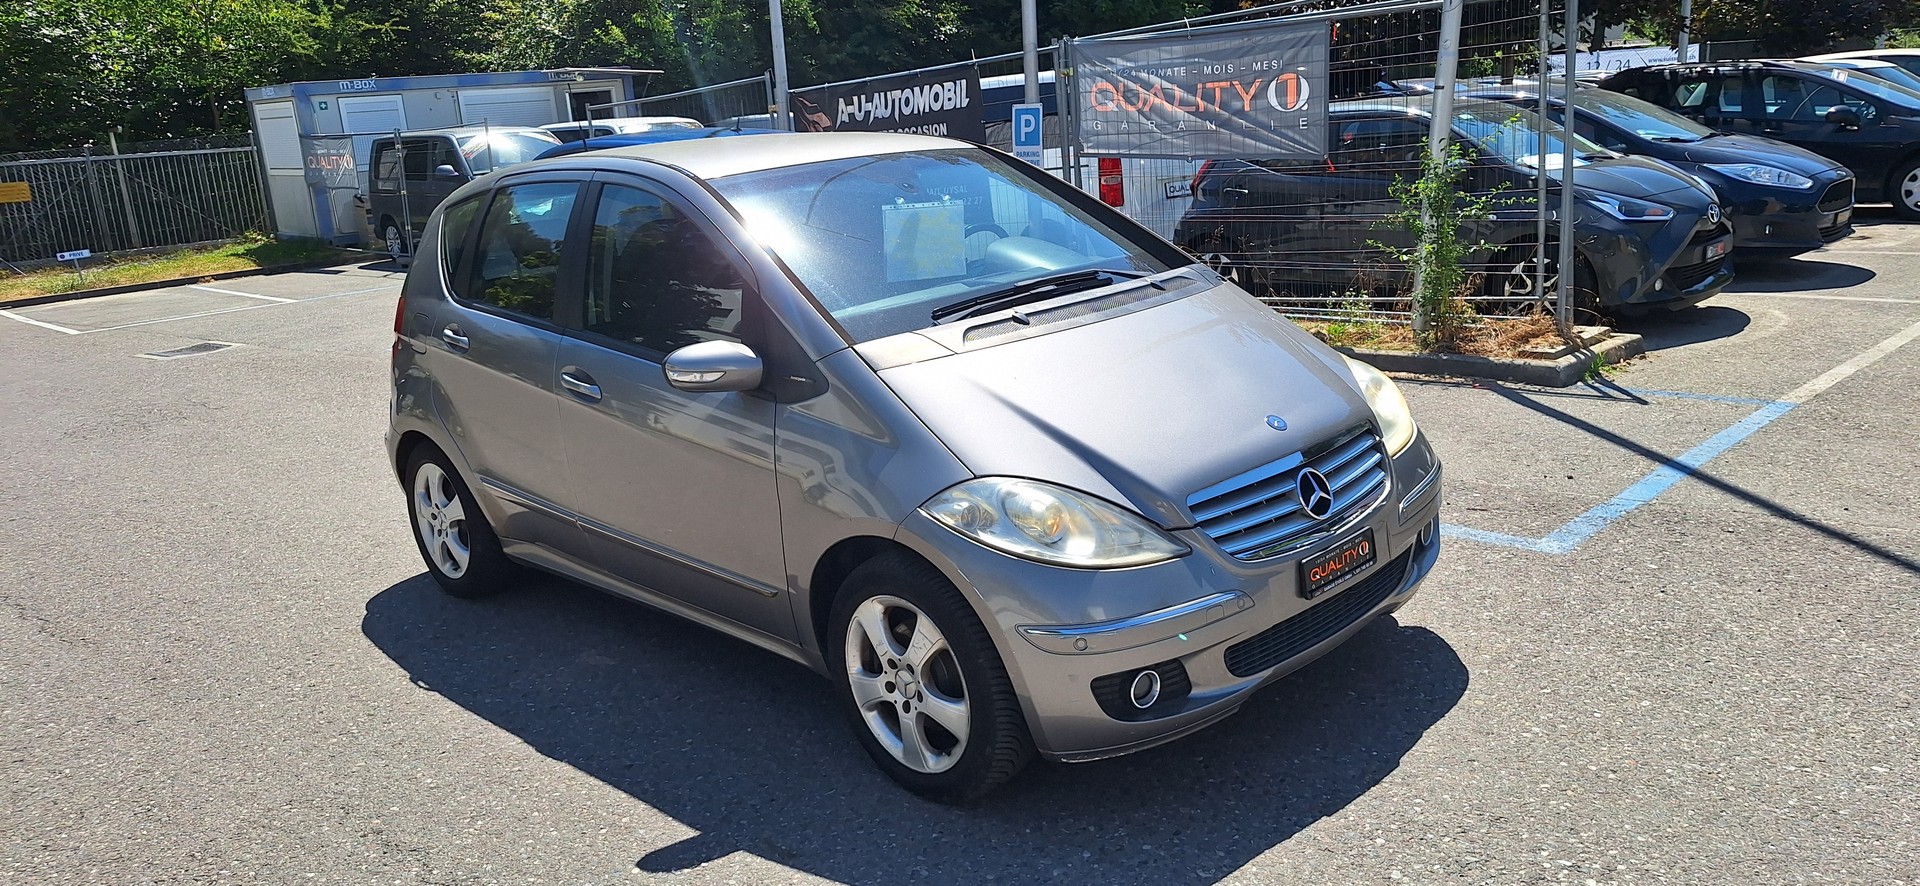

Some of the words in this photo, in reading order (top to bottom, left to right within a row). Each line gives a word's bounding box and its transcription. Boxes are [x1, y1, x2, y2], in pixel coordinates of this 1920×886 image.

[1140, 66, 1186, 77] MONATE
[1203, 64, 1234, 75] MOIS
[1252, 59, 1283, 71] MESI
[1091, 79, 1262, 112] QUALITY
[1020, 114, 1036, 142] P
[1093, 117, 1308, 132] GARANTIE
[308, 155, 343, 169] QUALITY
[1310, 546, 1358, 582] QUALITY
